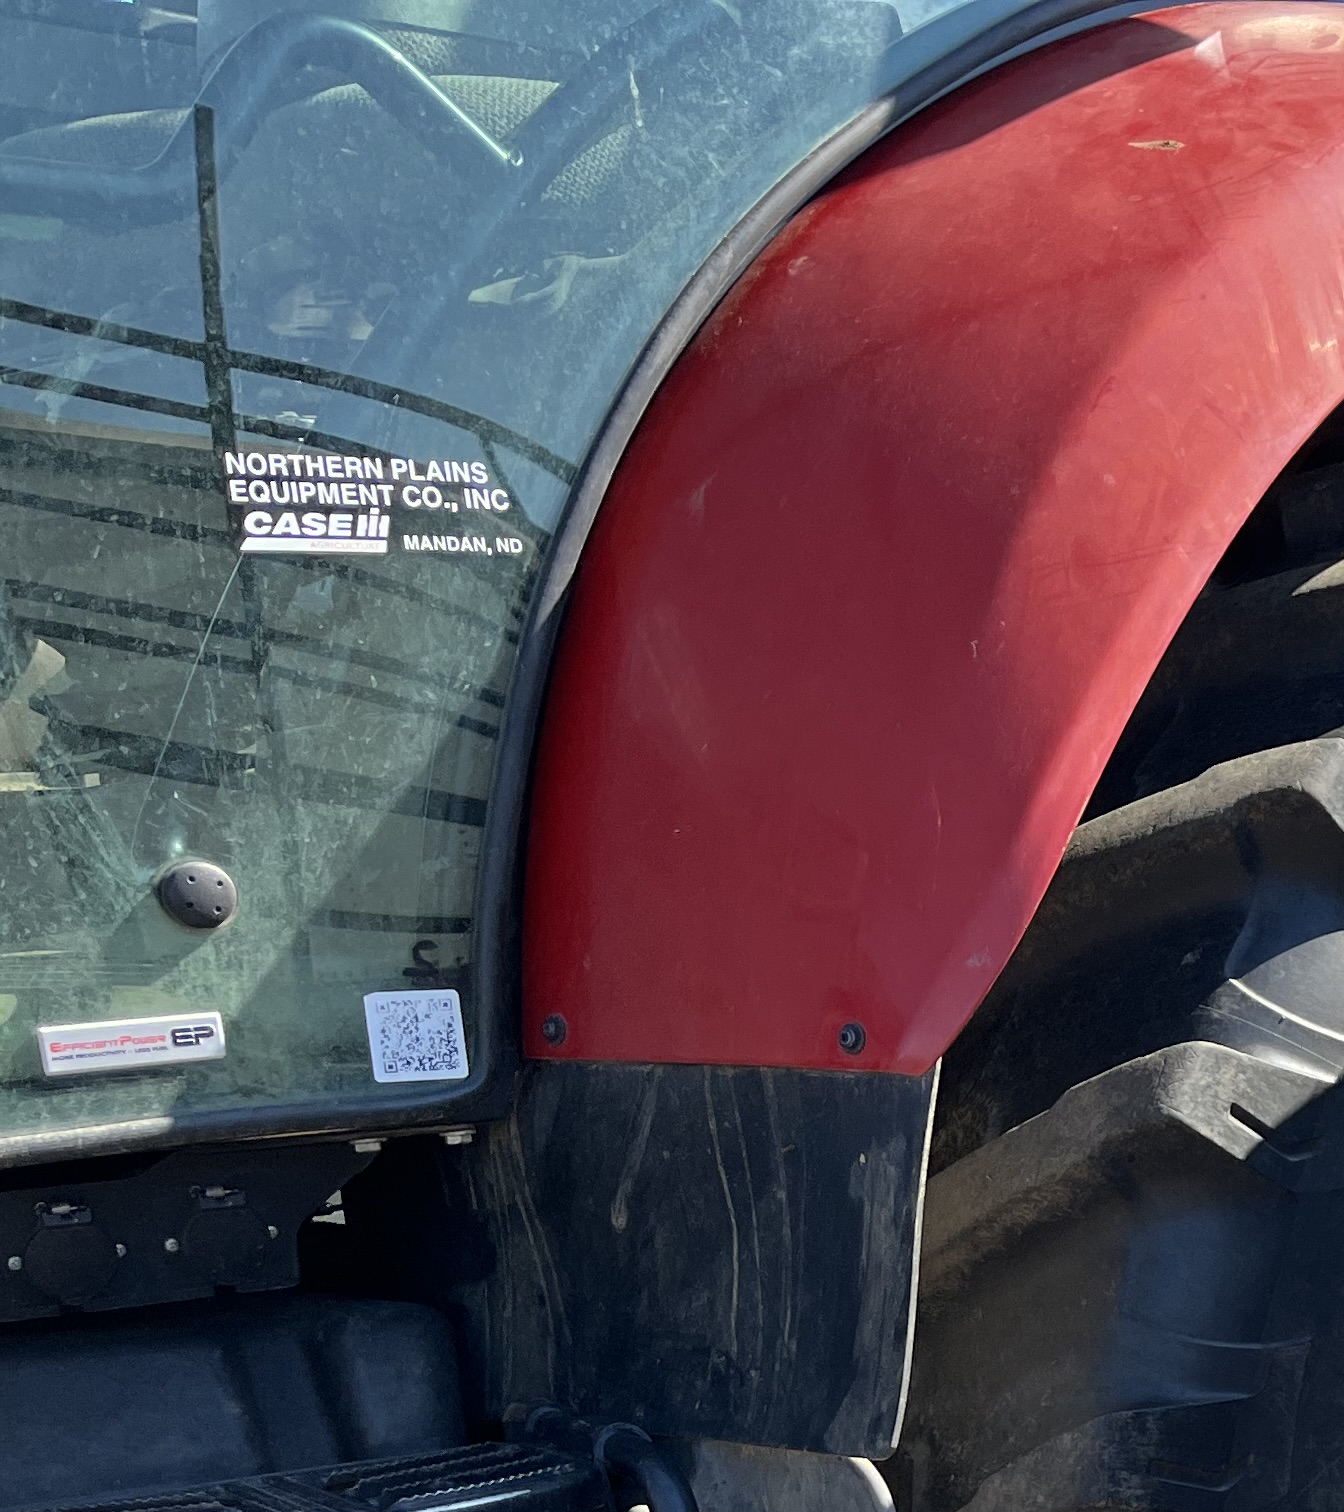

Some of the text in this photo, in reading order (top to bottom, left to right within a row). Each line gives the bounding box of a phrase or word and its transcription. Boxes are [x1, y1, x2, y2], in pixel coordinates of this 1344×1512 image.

[224, 451, 489, 484] NORTHERN PLAINS
[229, 479, 510, 512] EQUIPMENT CO., INC
[243, 510, 353, 537] CASE
[403, 534, 523, 556] MANDAN, ND
[170, 1025, 214, 1047] EP
